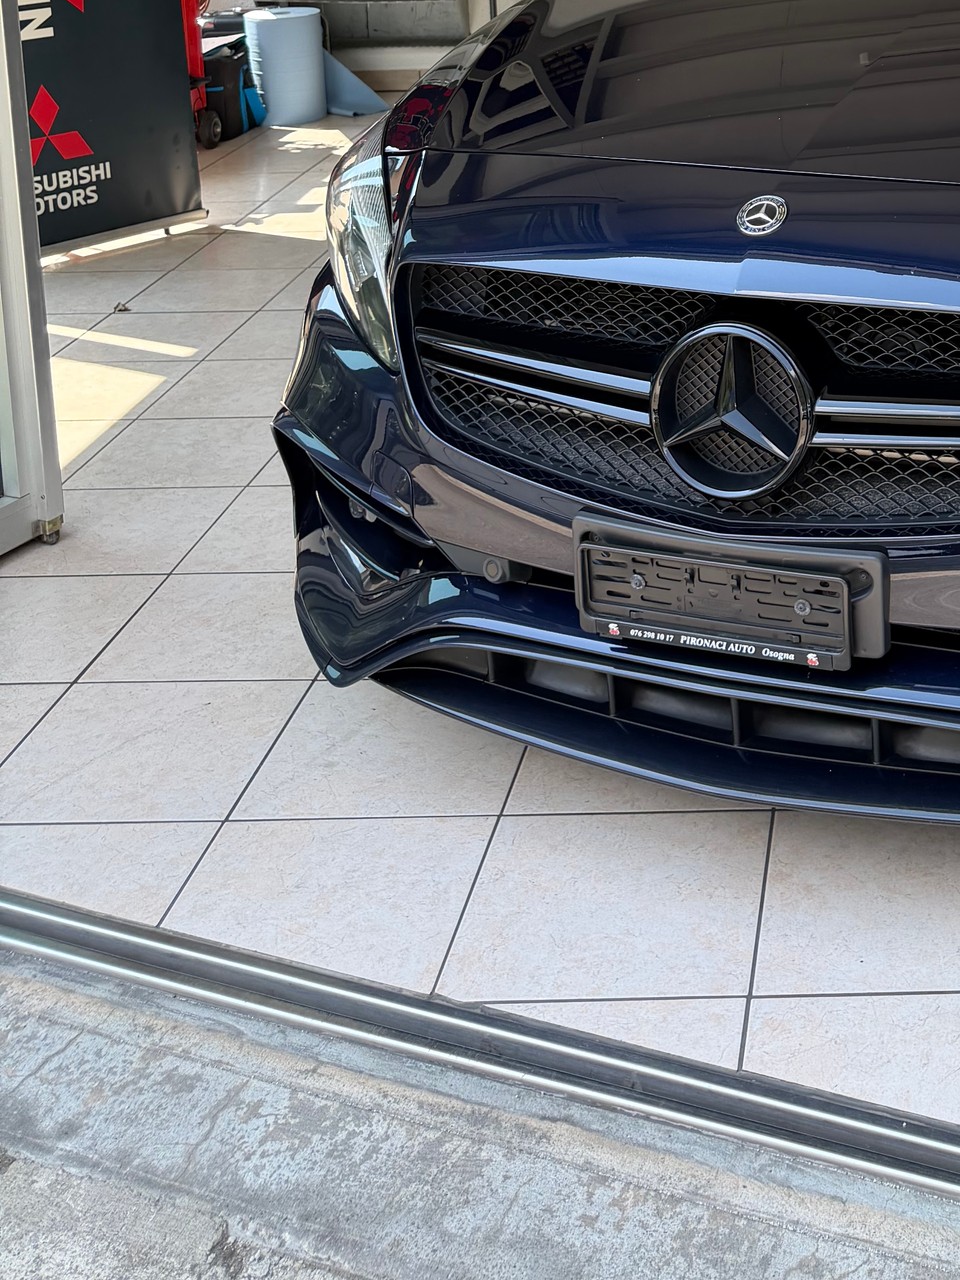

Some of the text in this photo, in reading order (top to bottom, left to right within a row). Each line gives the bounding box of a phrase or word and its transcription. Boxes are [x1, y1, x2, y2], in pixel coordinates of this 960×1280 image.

[630, 628, 796, 661] 076 298 10 17 PIRONACI AUTO Osogna
